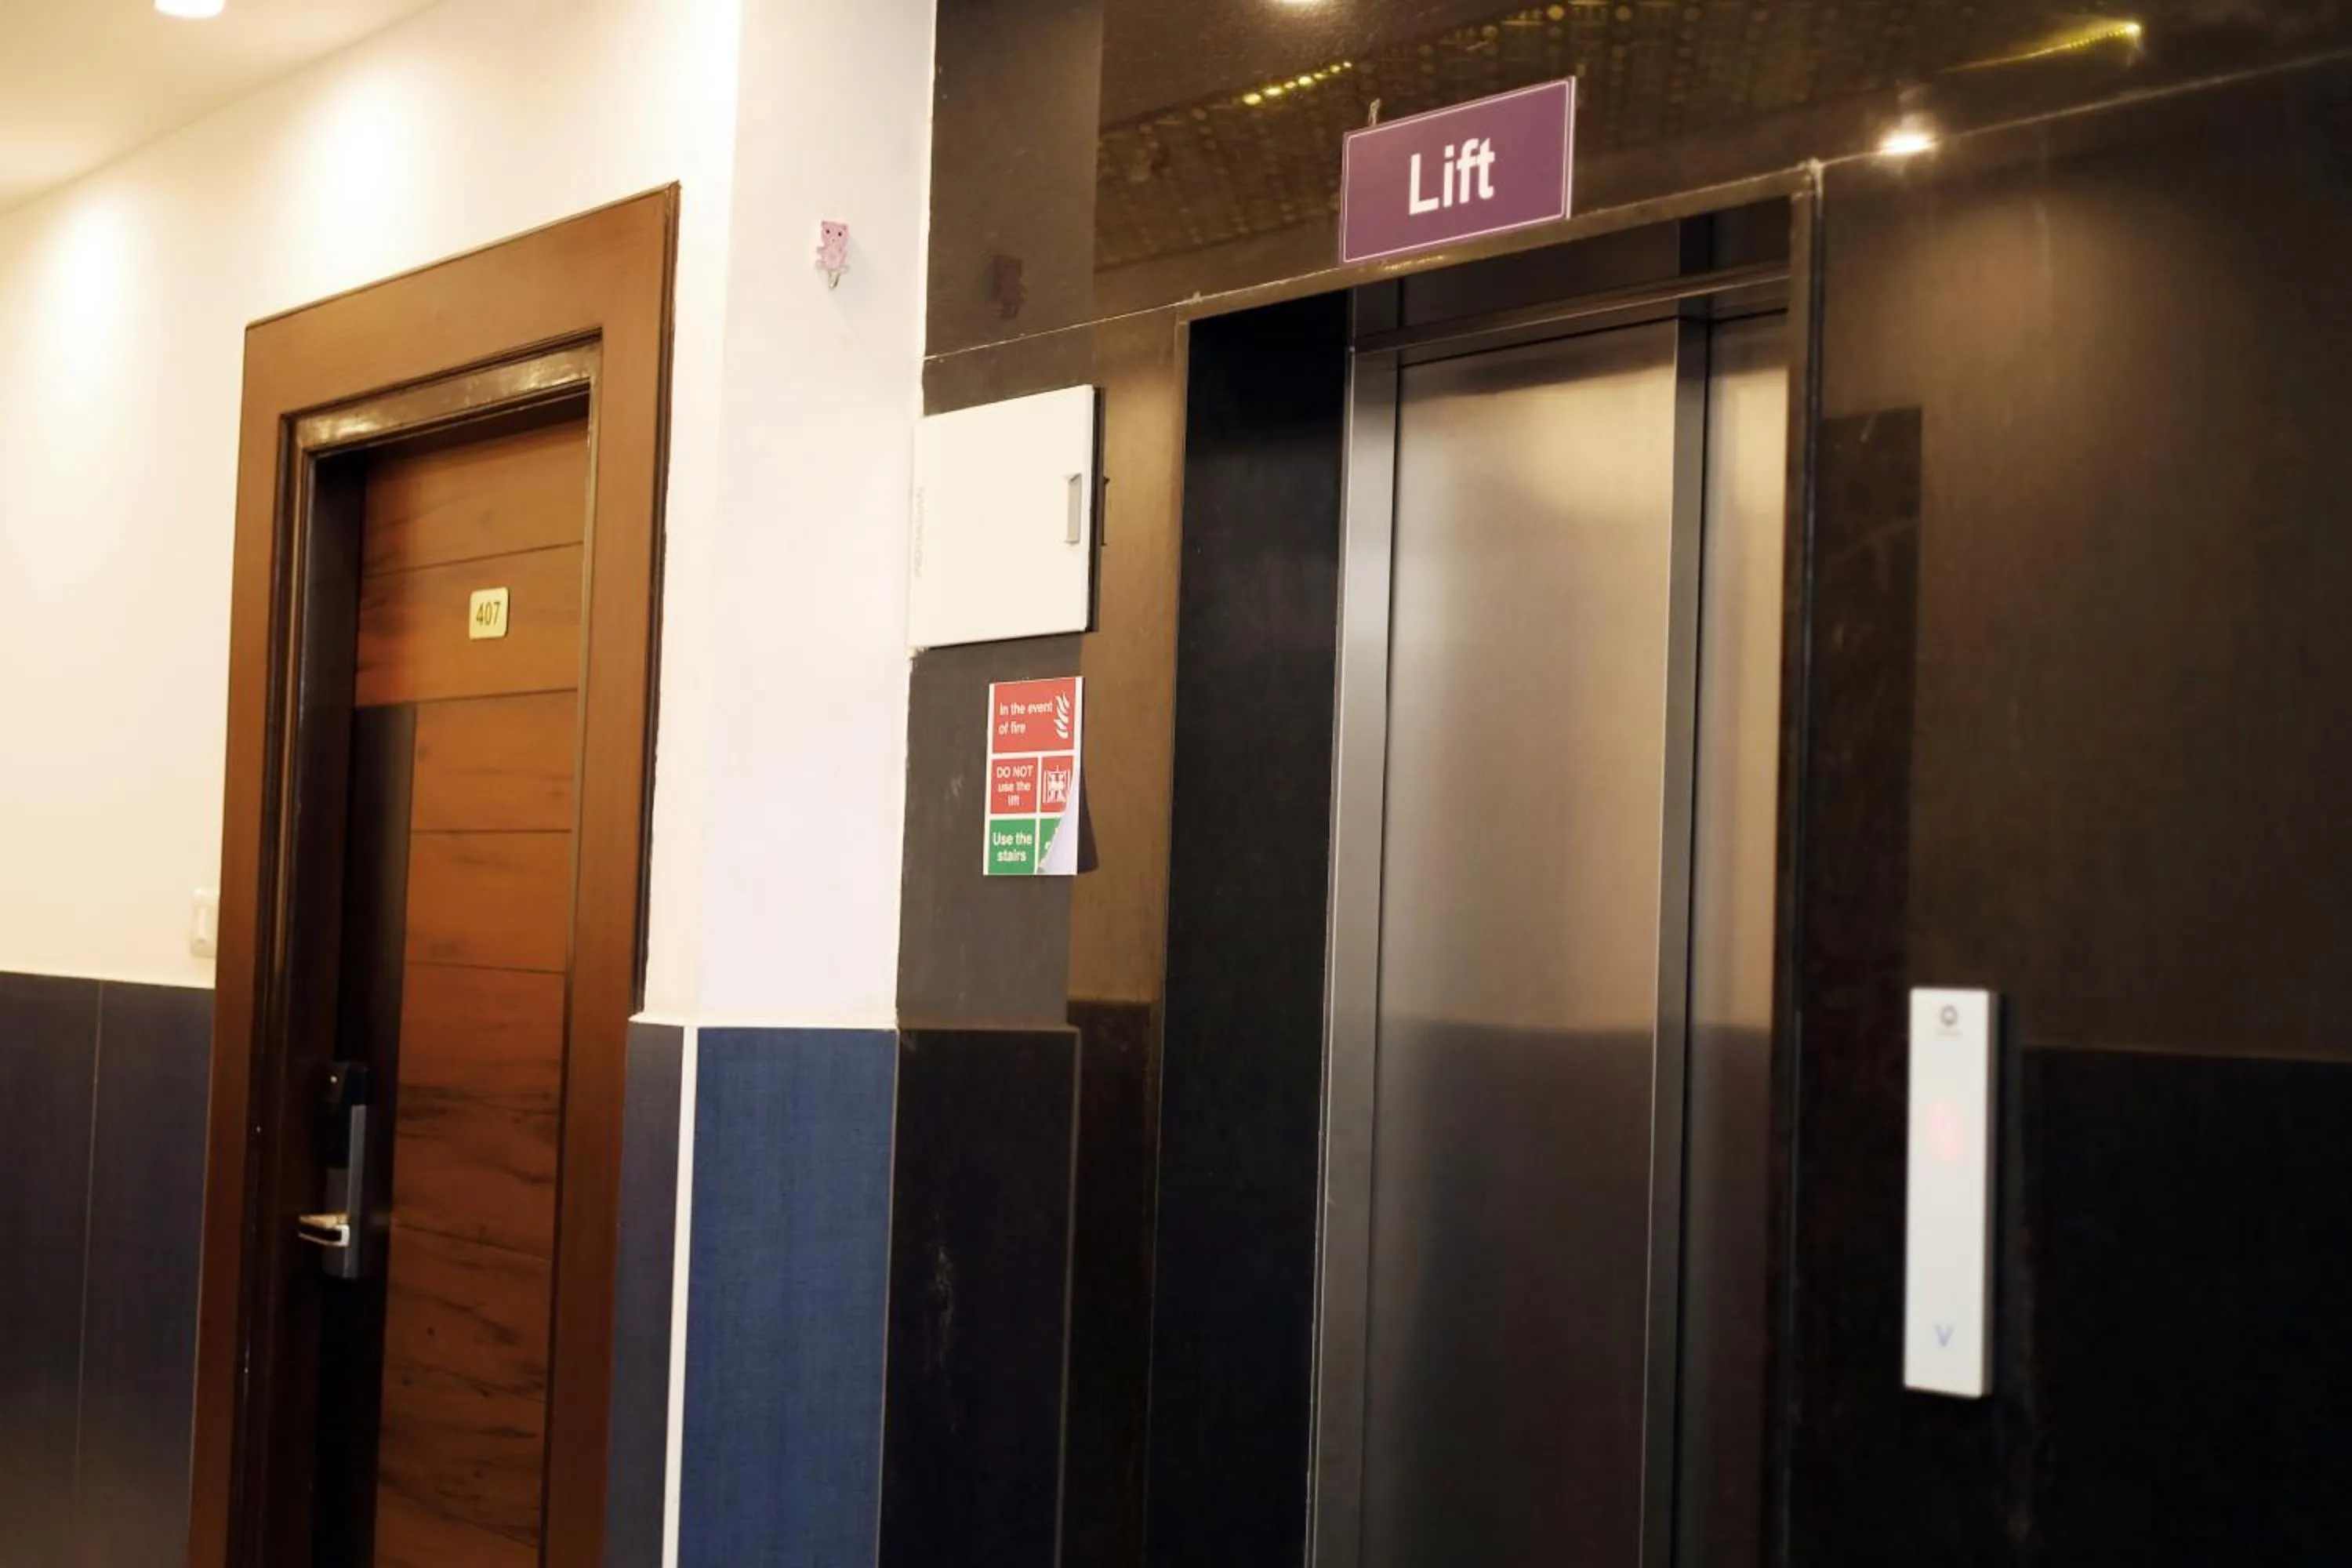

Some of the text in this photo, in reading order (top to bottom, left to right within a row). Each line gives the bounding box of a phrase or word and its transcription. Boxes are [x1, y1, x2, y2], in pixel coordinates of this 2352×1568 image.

[1409, 138, 1495, 216] Lift
[476, 601, 500, 626] 407
[999, 702, 1053, 715] In the event
[998, 720, 1026, 735] of fire
[996, 765, 1033, 779] DO NOT
[997, 781, 1031, 793] use the
[1007, 793, 1020, 806] lift
[993, 830, 1033, 846] Use the
[996, 848, 1027, 862] stairs
